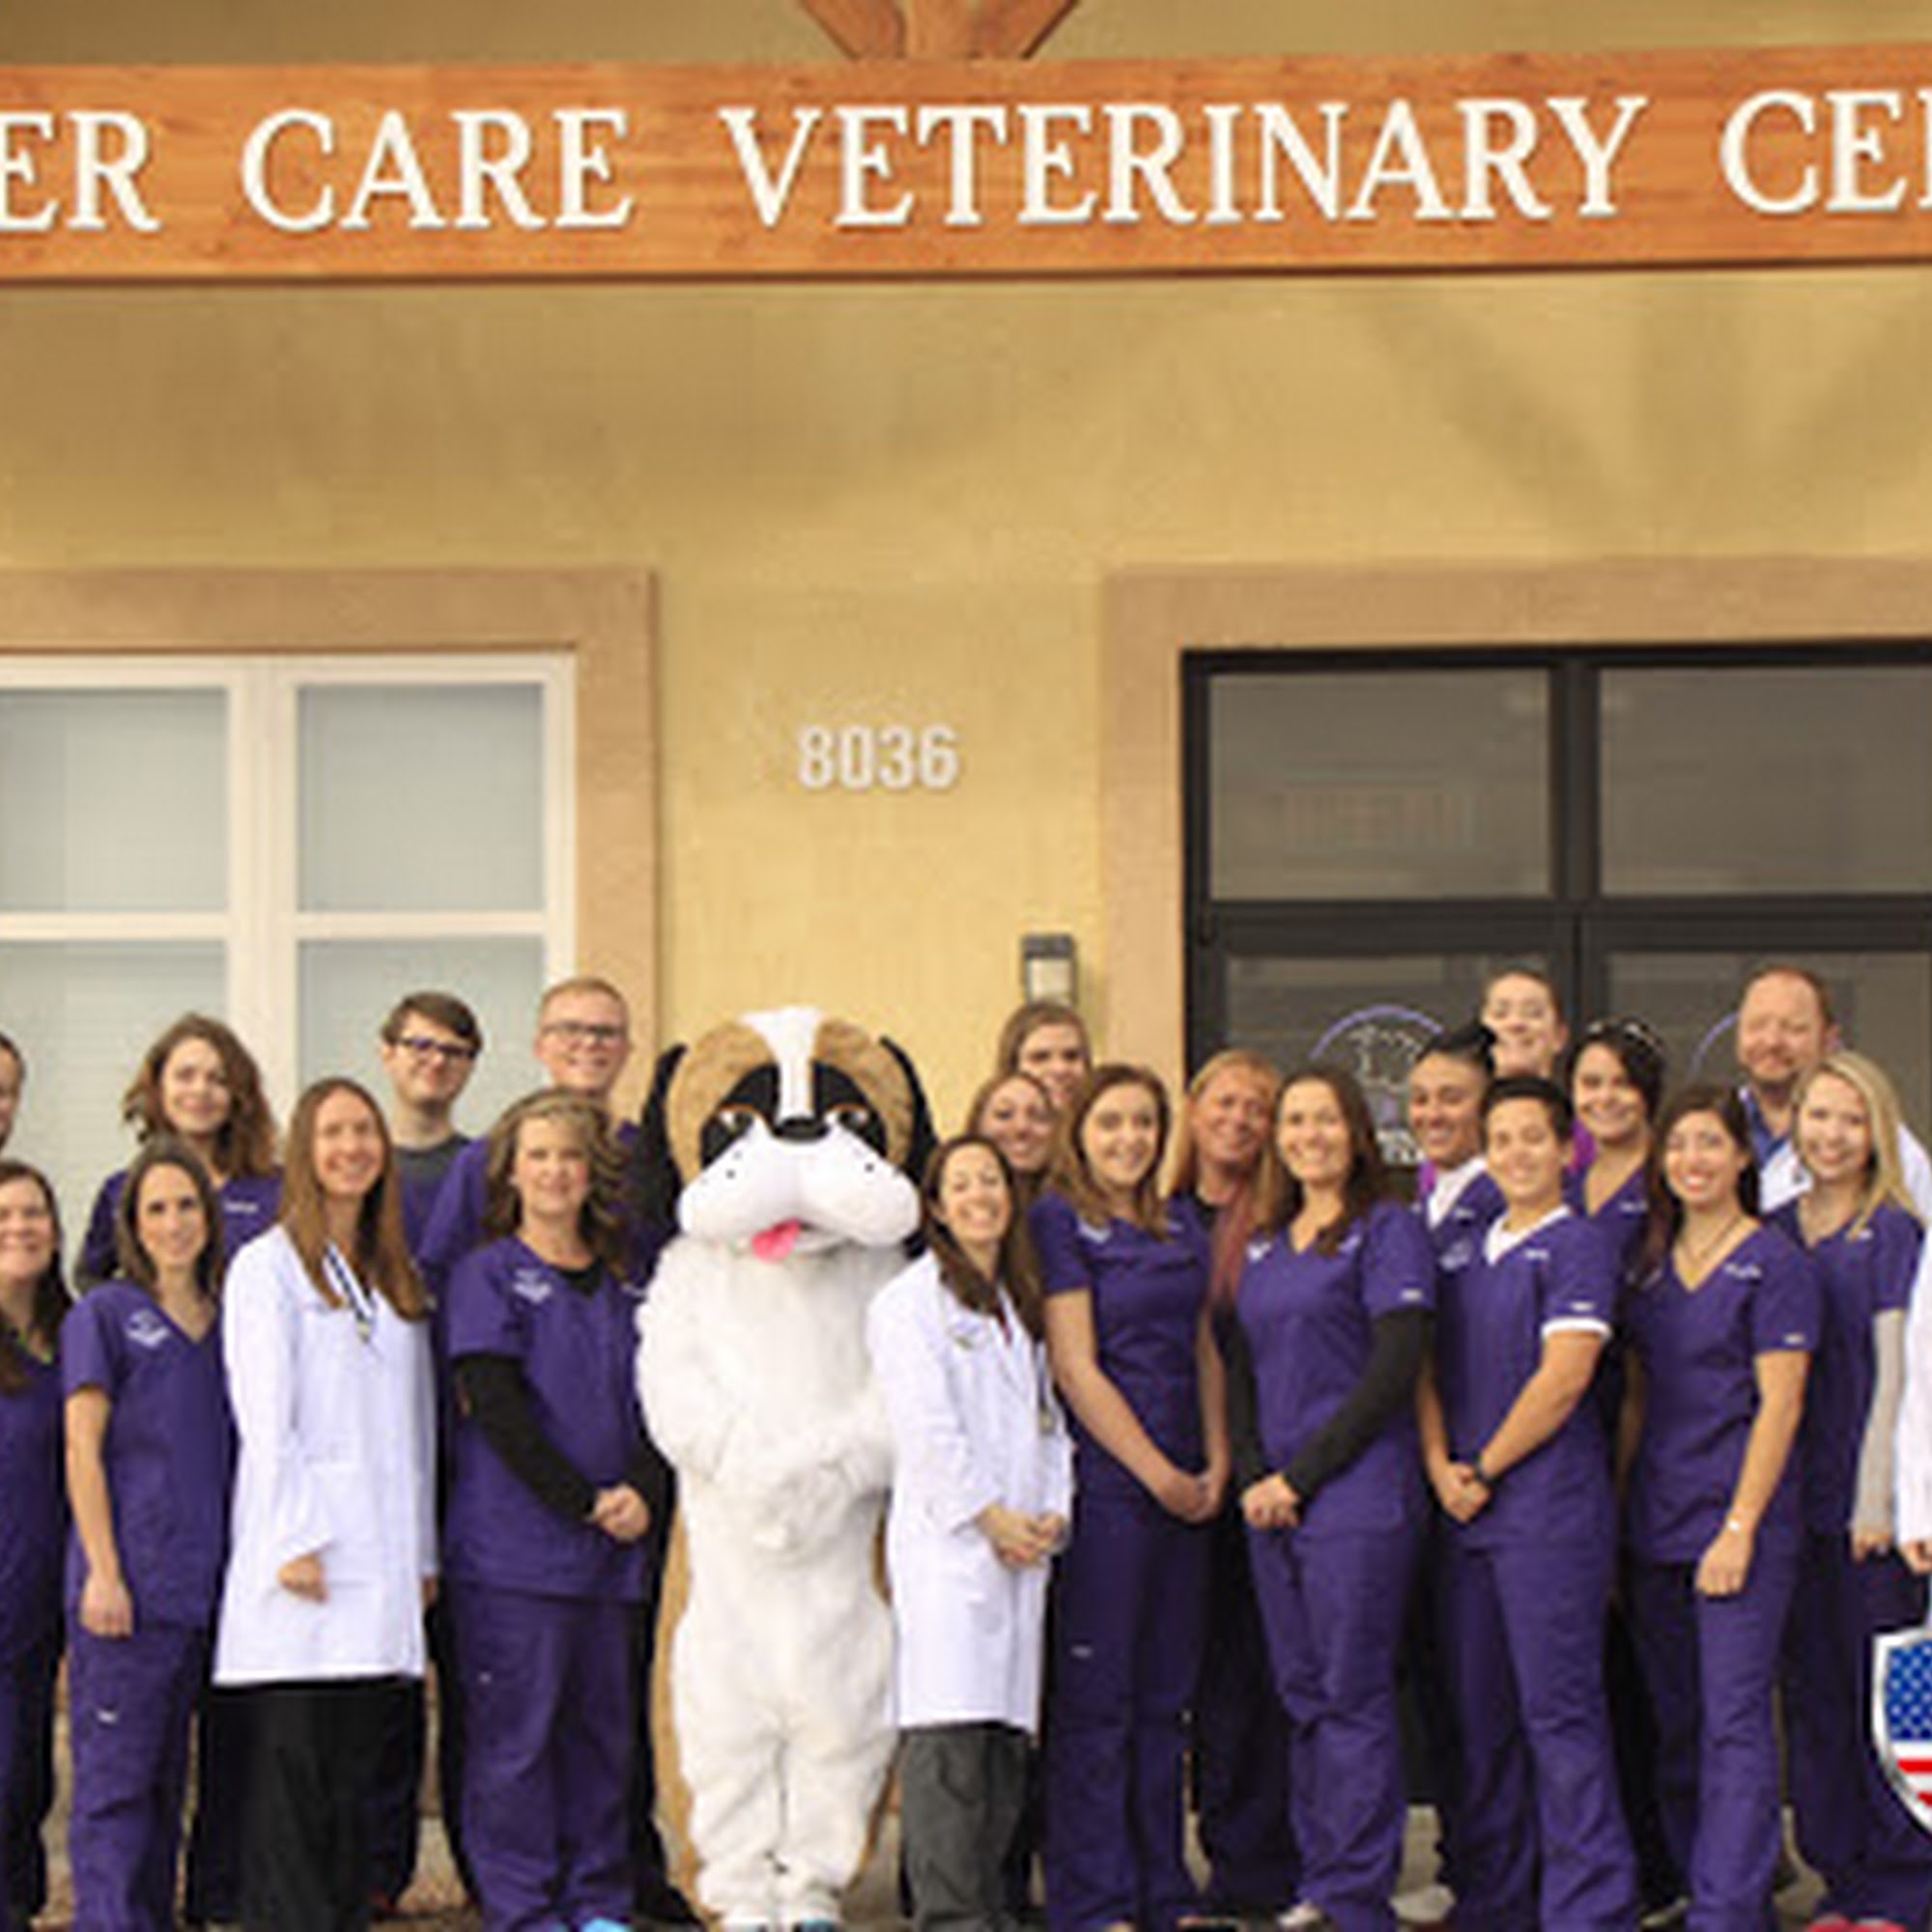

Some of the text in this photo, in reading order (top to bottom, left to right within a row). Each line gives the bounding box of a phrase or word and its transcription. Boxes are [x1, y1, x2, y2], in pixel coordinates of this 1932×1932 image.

[241, 108, 633, 231] CARE
[719, 96, 1647, 229] VETERINARY
[1719, 88, 1932, 213] CE
[798, 724, 959, 790] 8036
